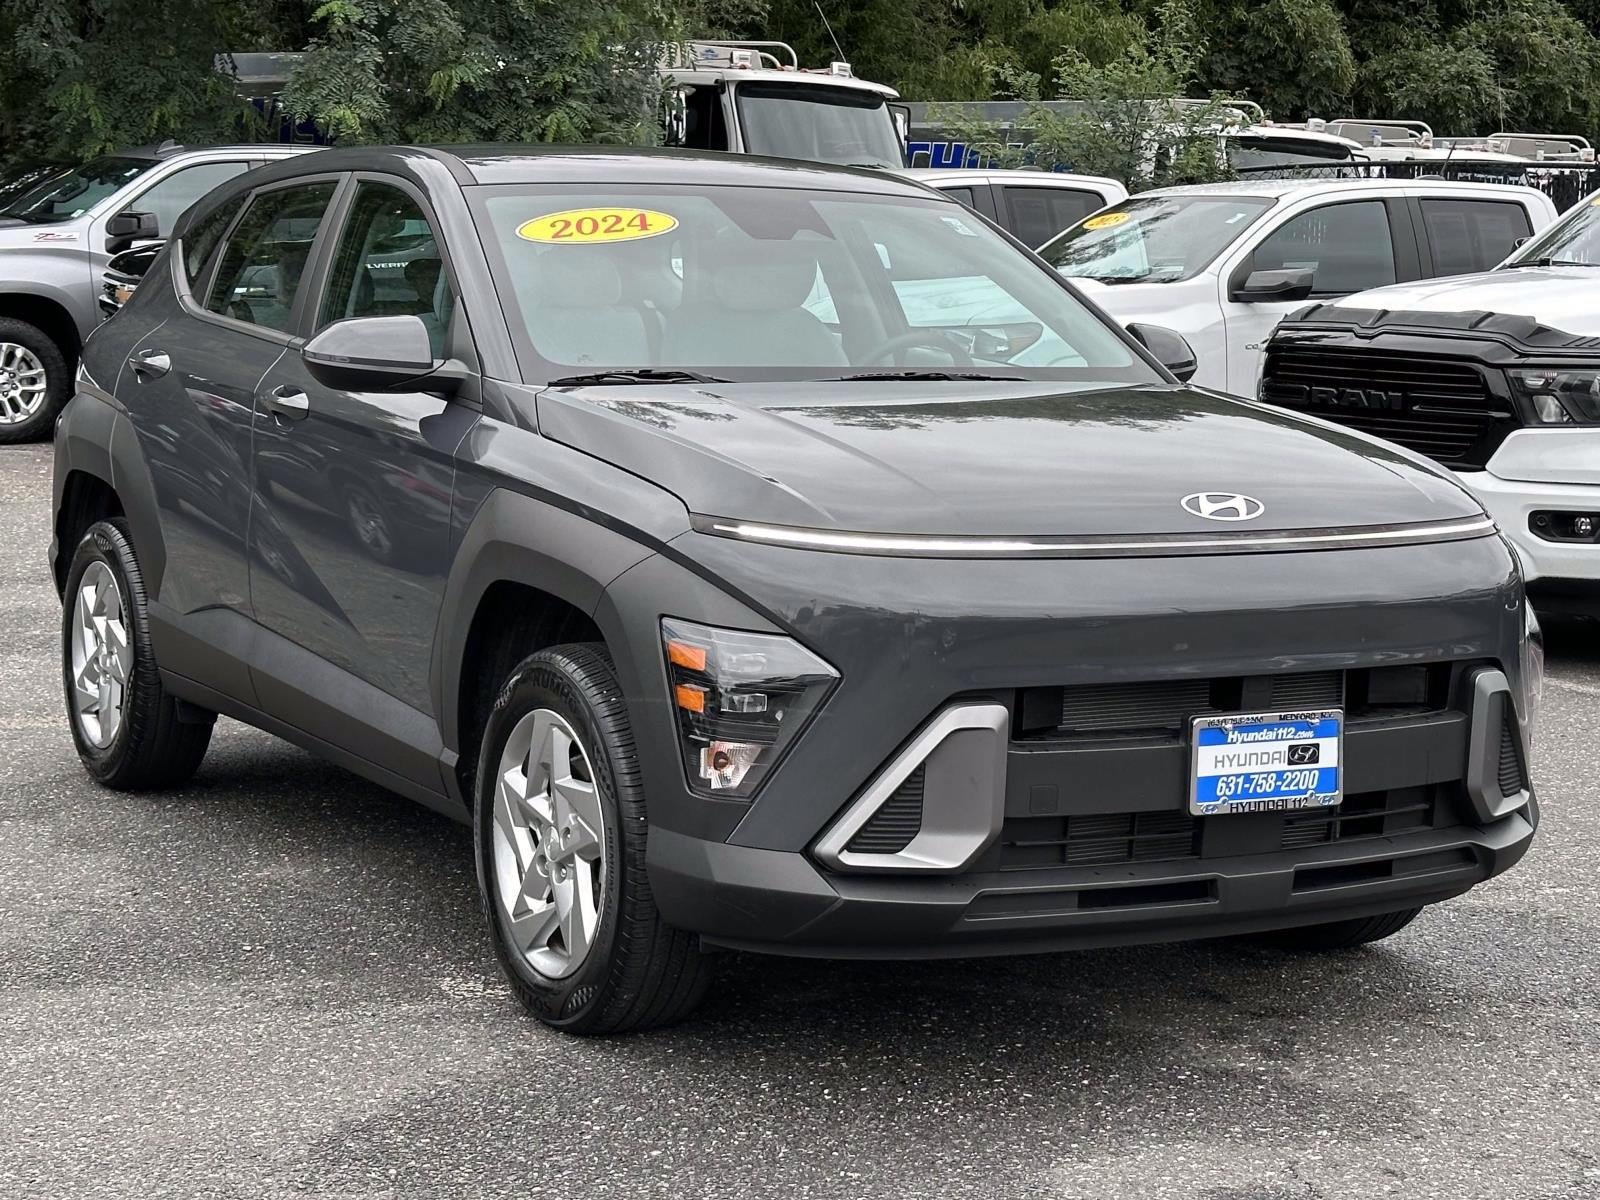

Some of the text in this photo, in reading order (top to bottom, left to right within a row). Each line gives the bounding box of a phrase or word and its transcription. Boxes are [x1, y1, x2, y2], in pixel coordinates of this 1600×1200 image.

[550, 213, 652, 239] 2024
[1312, 386, 1402, 410] RAM
[1227, 727, 1314, 744] Hyundai112.com
[1214, 750, 1286, 769] HYUNDAI
[1216, 770, 1319, 796] 631-758-2200
[1230, 799, 1287, 813] HYUNDAI
